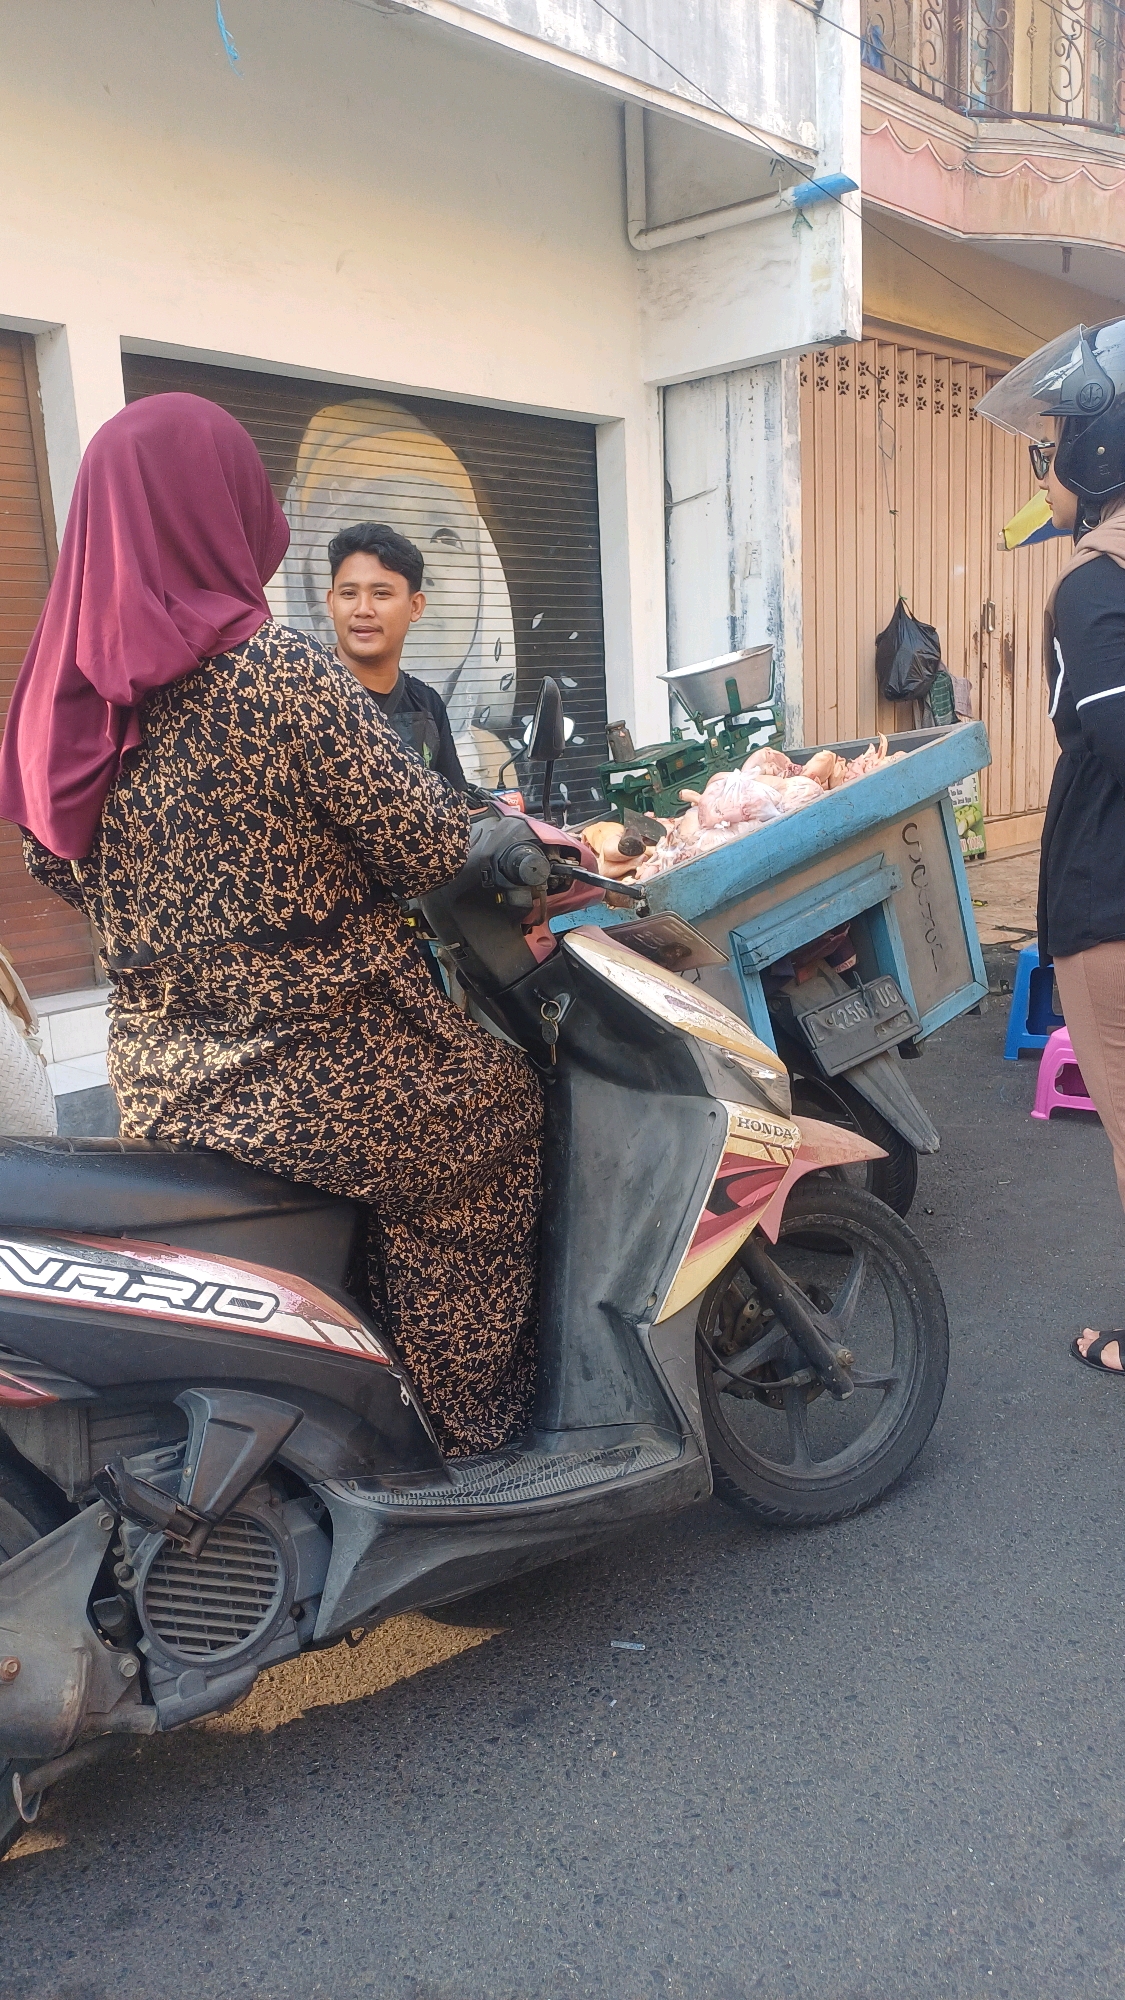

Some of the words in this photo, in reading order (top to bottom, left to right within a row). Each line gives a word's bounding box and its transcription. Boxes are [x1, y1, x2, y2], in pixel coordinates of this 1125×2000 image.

[832, 1000, 869, 1031] 4256
[876, 983, 899, 1009] UC
[737, 1116, 794, 1141] HONDA
[0, 1244, 281, 1323] VARIO
